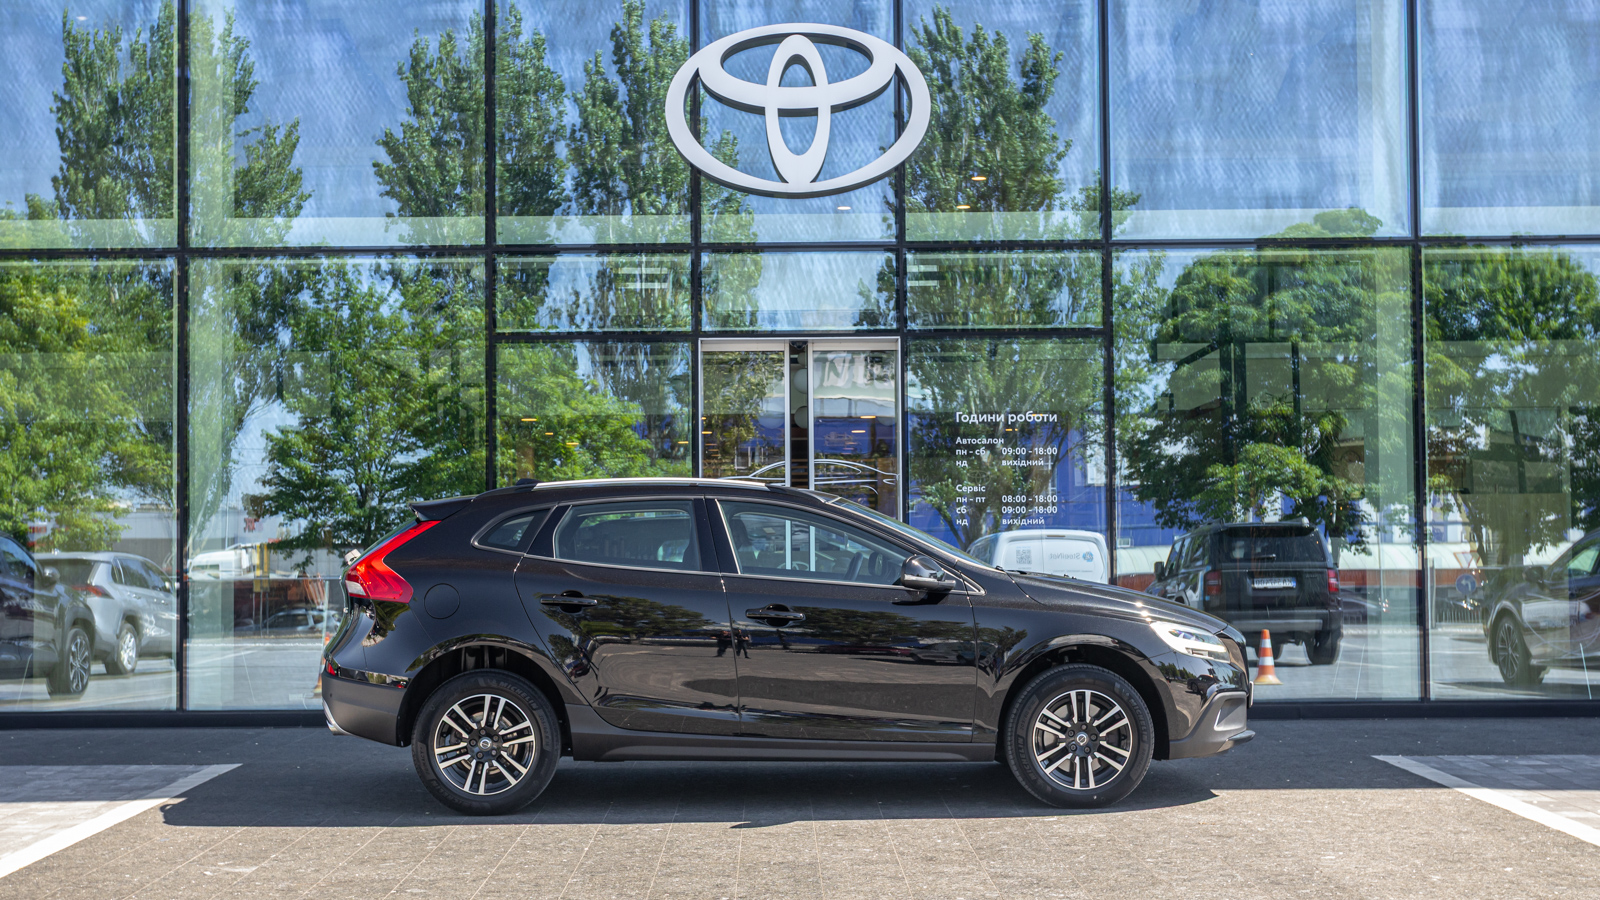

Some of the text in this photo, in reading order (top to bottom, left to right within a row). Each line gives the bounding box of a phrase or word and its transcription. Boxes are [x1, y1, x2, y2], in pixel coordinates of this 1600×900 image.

[956, 411, 1058, 424] Години роботи
[955, 437, 1004, 445] Автосалон
[956, 448, 967, 456] пн
[975, 448, 986, 456] сб
[1002, 447, 1026, 455] 09:00
[1035, 447, 1058, 455] 18:00
[1002, 459, 1044, 467] вихідний
[956, 484, 986, 494] Сервіс
[956, 506, 967, 514] сб
[1002, 506, 1026, 514] 09:00
[1035, 506, 1058, 514] 18:00
[956, 517, 1045, 526] нд вихідний
[498, 680, 540, 711] MICHELIN
[1017, 736, 1037, 781] MICHELIN
